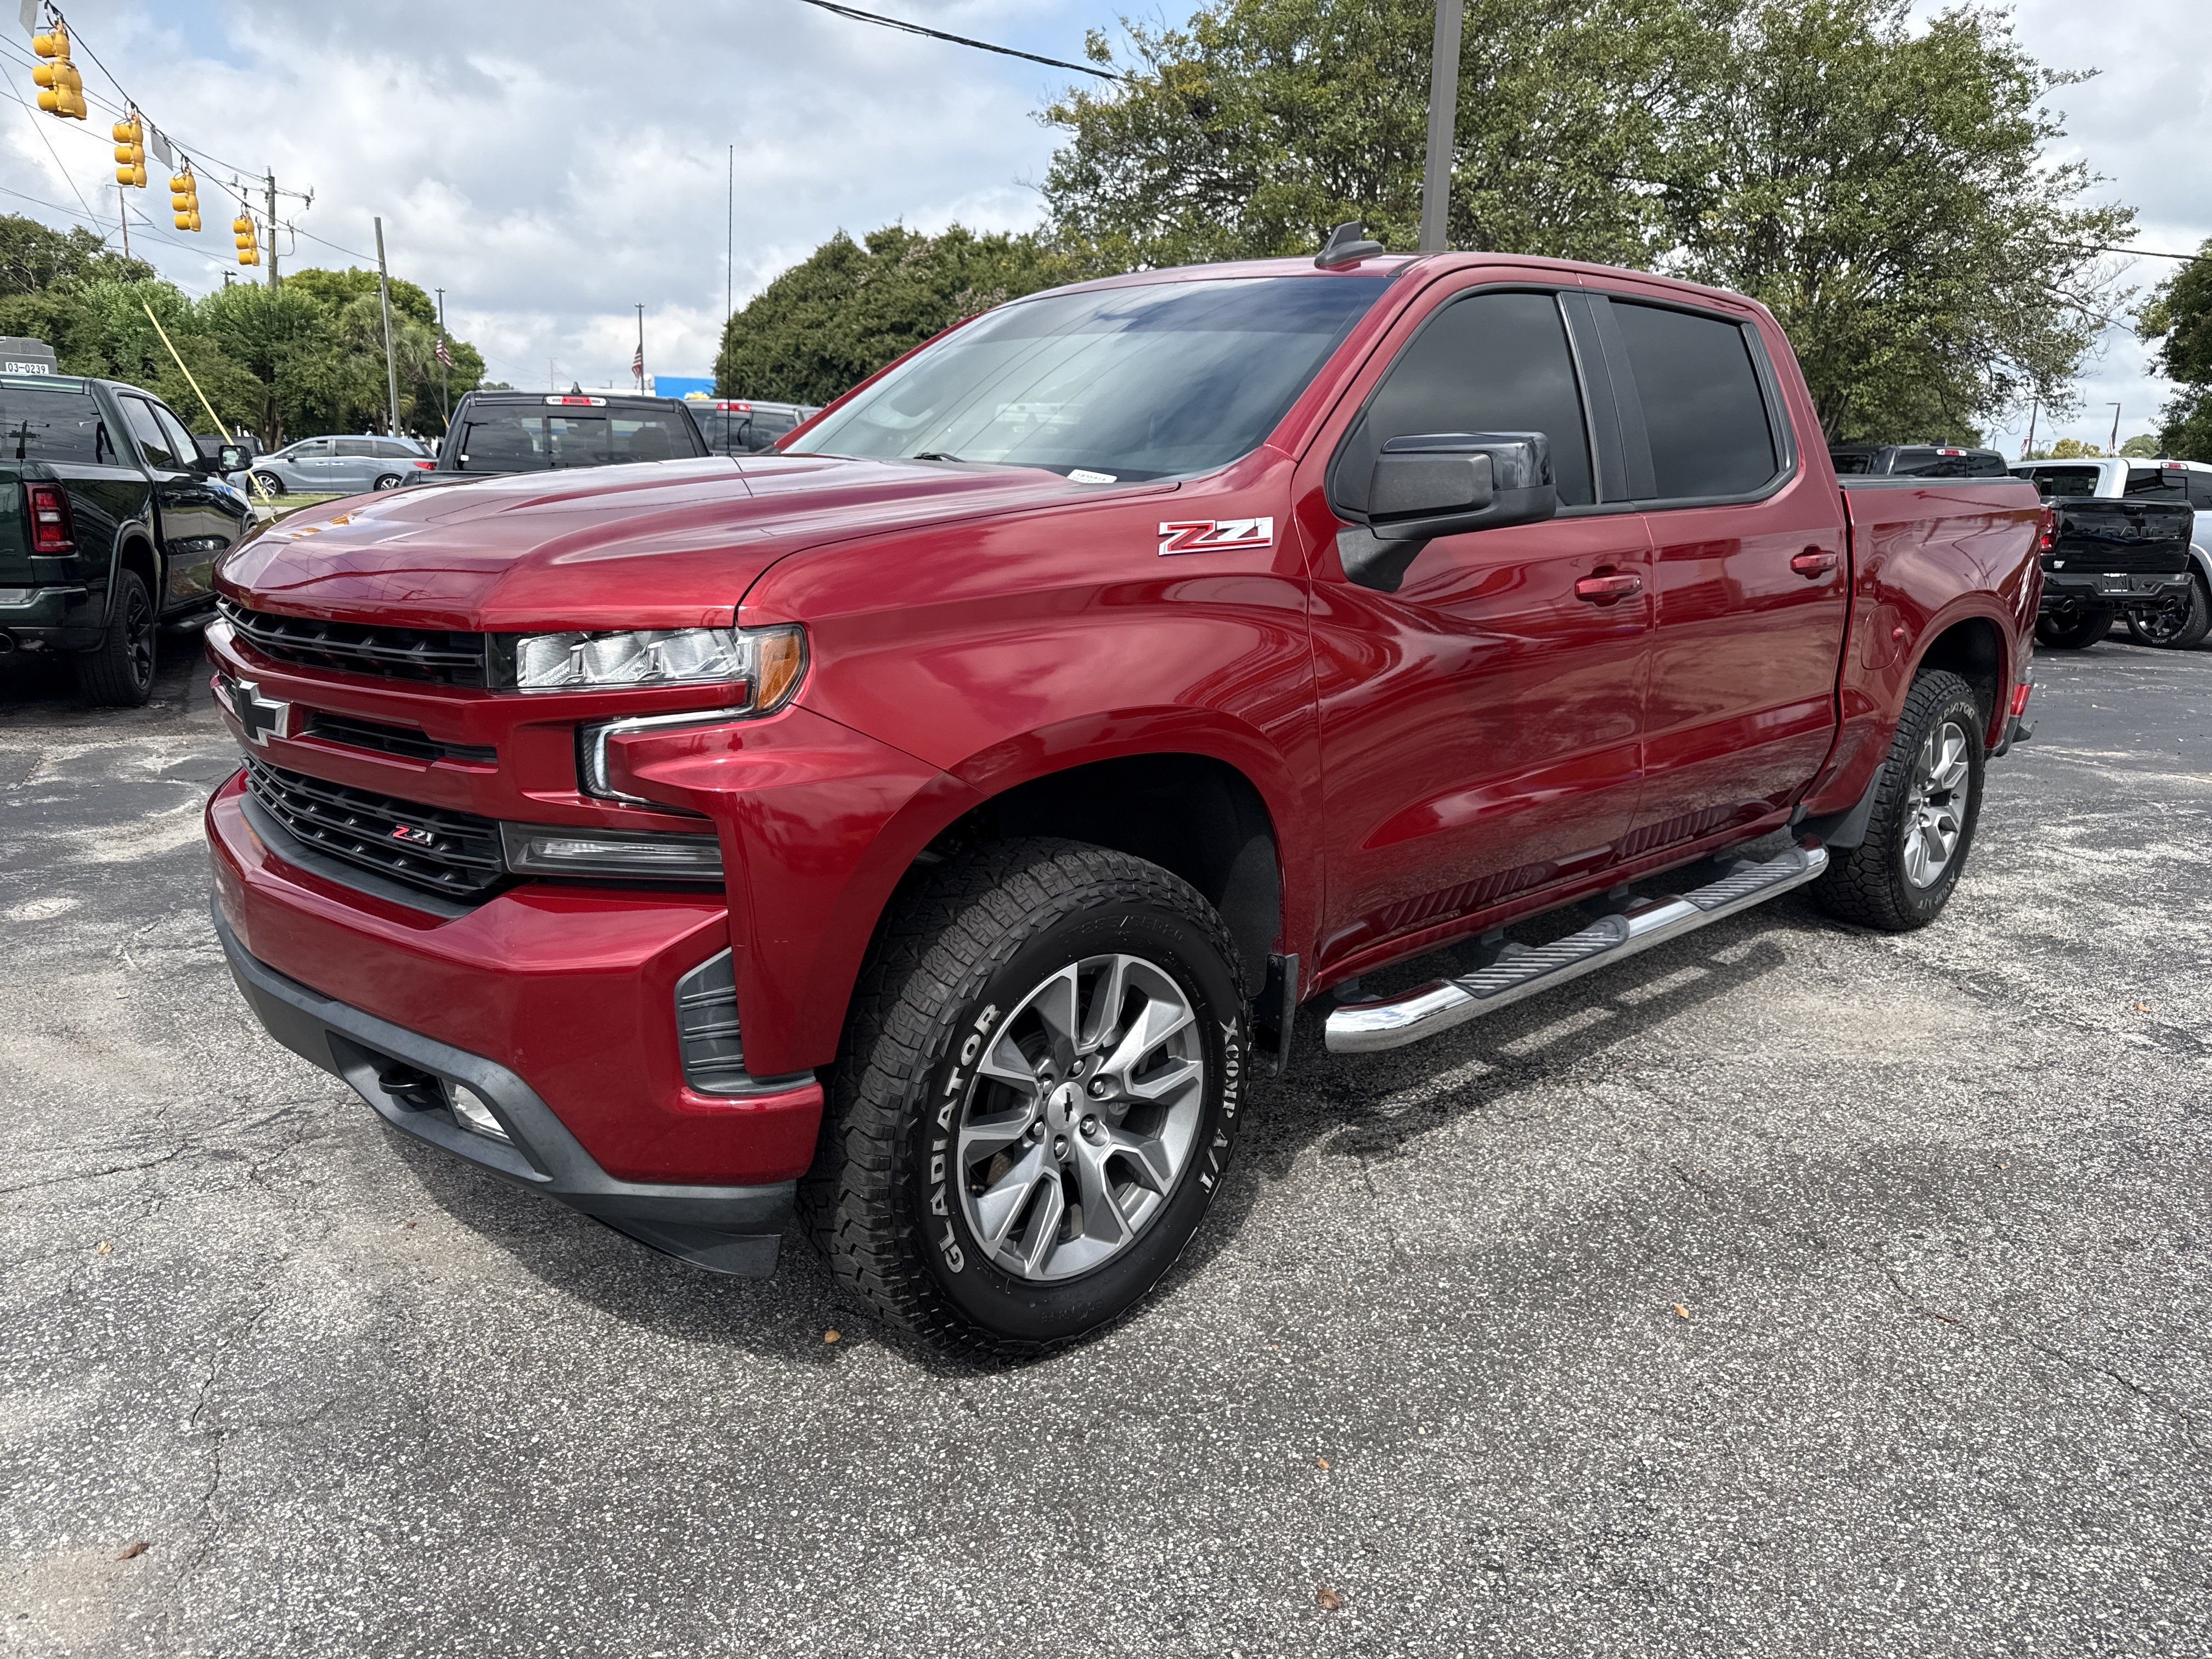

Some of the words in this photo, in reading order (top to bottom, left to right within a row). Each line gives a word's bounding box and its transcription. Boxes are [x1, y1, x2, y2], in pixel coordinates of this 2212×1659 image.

[8, 363, 46, 374] 03-0239
[1158, 517, 1273, 556] Z71
[392, 824, 435, 845] Z71
[930, 1002, 1001, 1273] GLADIATOR
